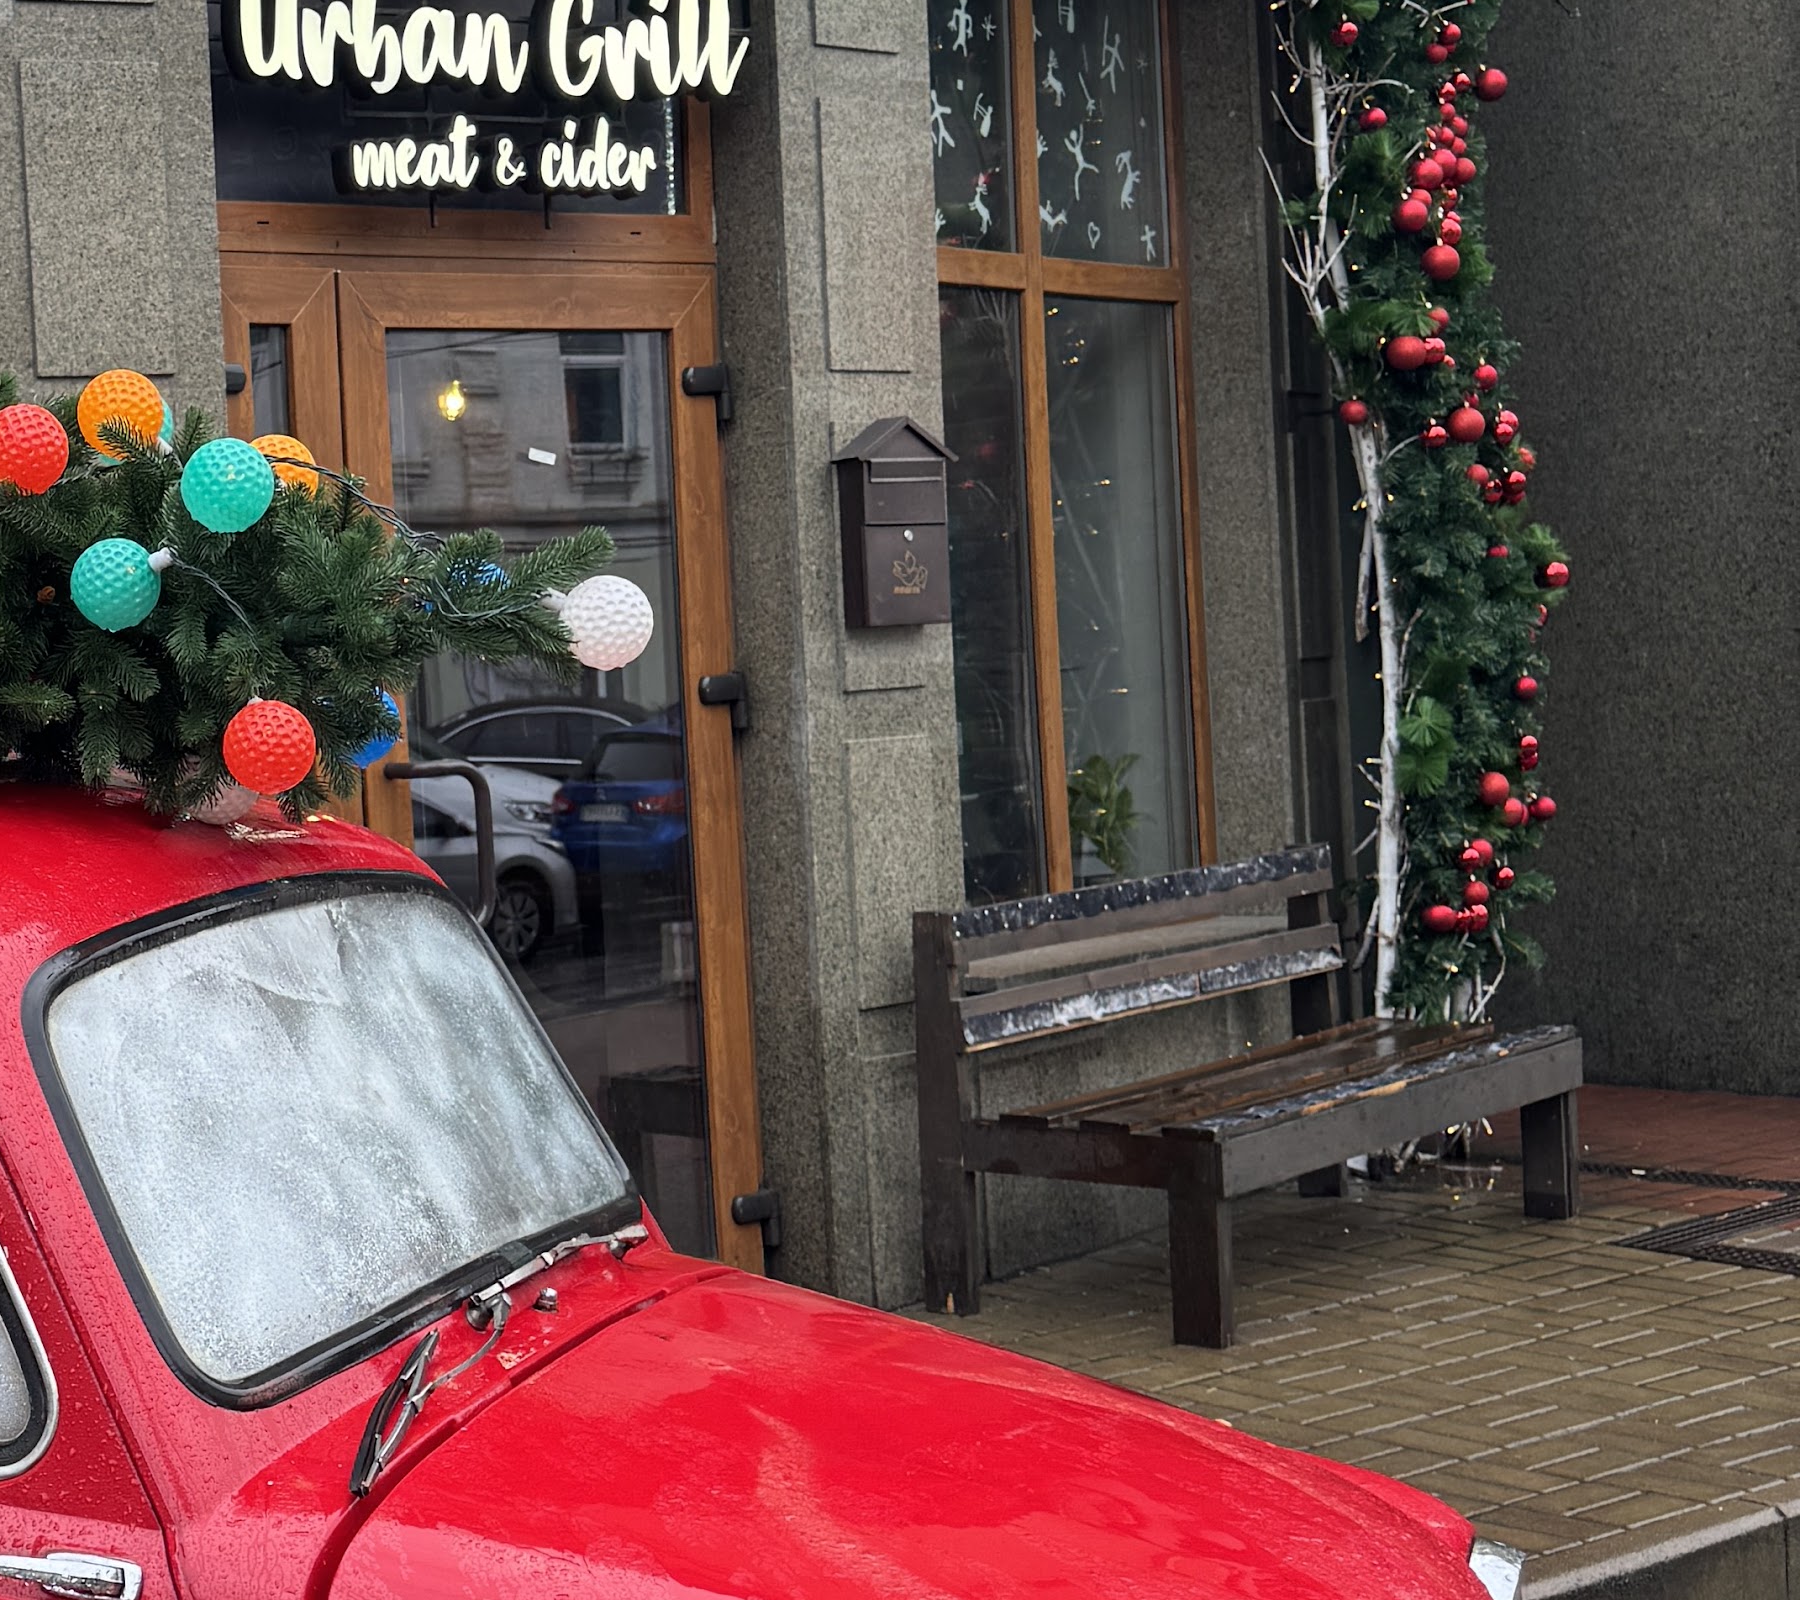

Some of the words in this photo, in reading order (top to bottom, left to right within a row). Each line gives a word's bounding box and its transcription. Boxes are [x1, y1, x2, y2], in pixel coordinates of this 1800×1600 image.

[353, 114, 480, 189] meat
[495, 137, 527, 187] &
[540, 116, 657, 192] cider
